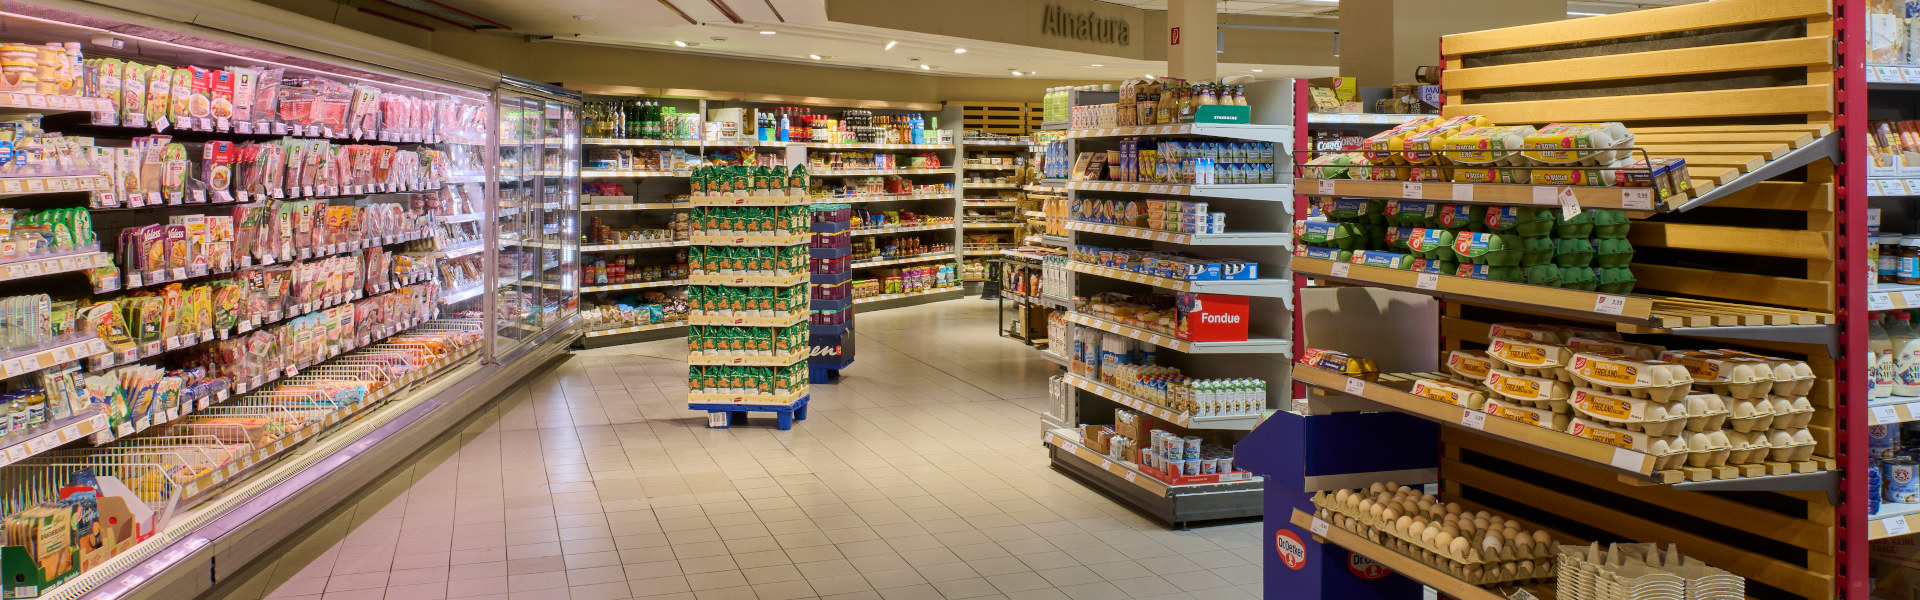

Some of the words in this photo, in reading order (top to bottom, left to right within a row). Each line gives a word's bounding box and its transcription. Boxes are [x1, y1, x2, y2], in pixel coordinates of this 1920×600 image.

[1043, 5, 1130, 46] Alnatura
[1316, 139, 1343, 151] CORNY
[1340, 136, 1364, 147] ORNY
[168, 228, 185, 238] Valess
[1201, 312, 1241, 324] Fondue
